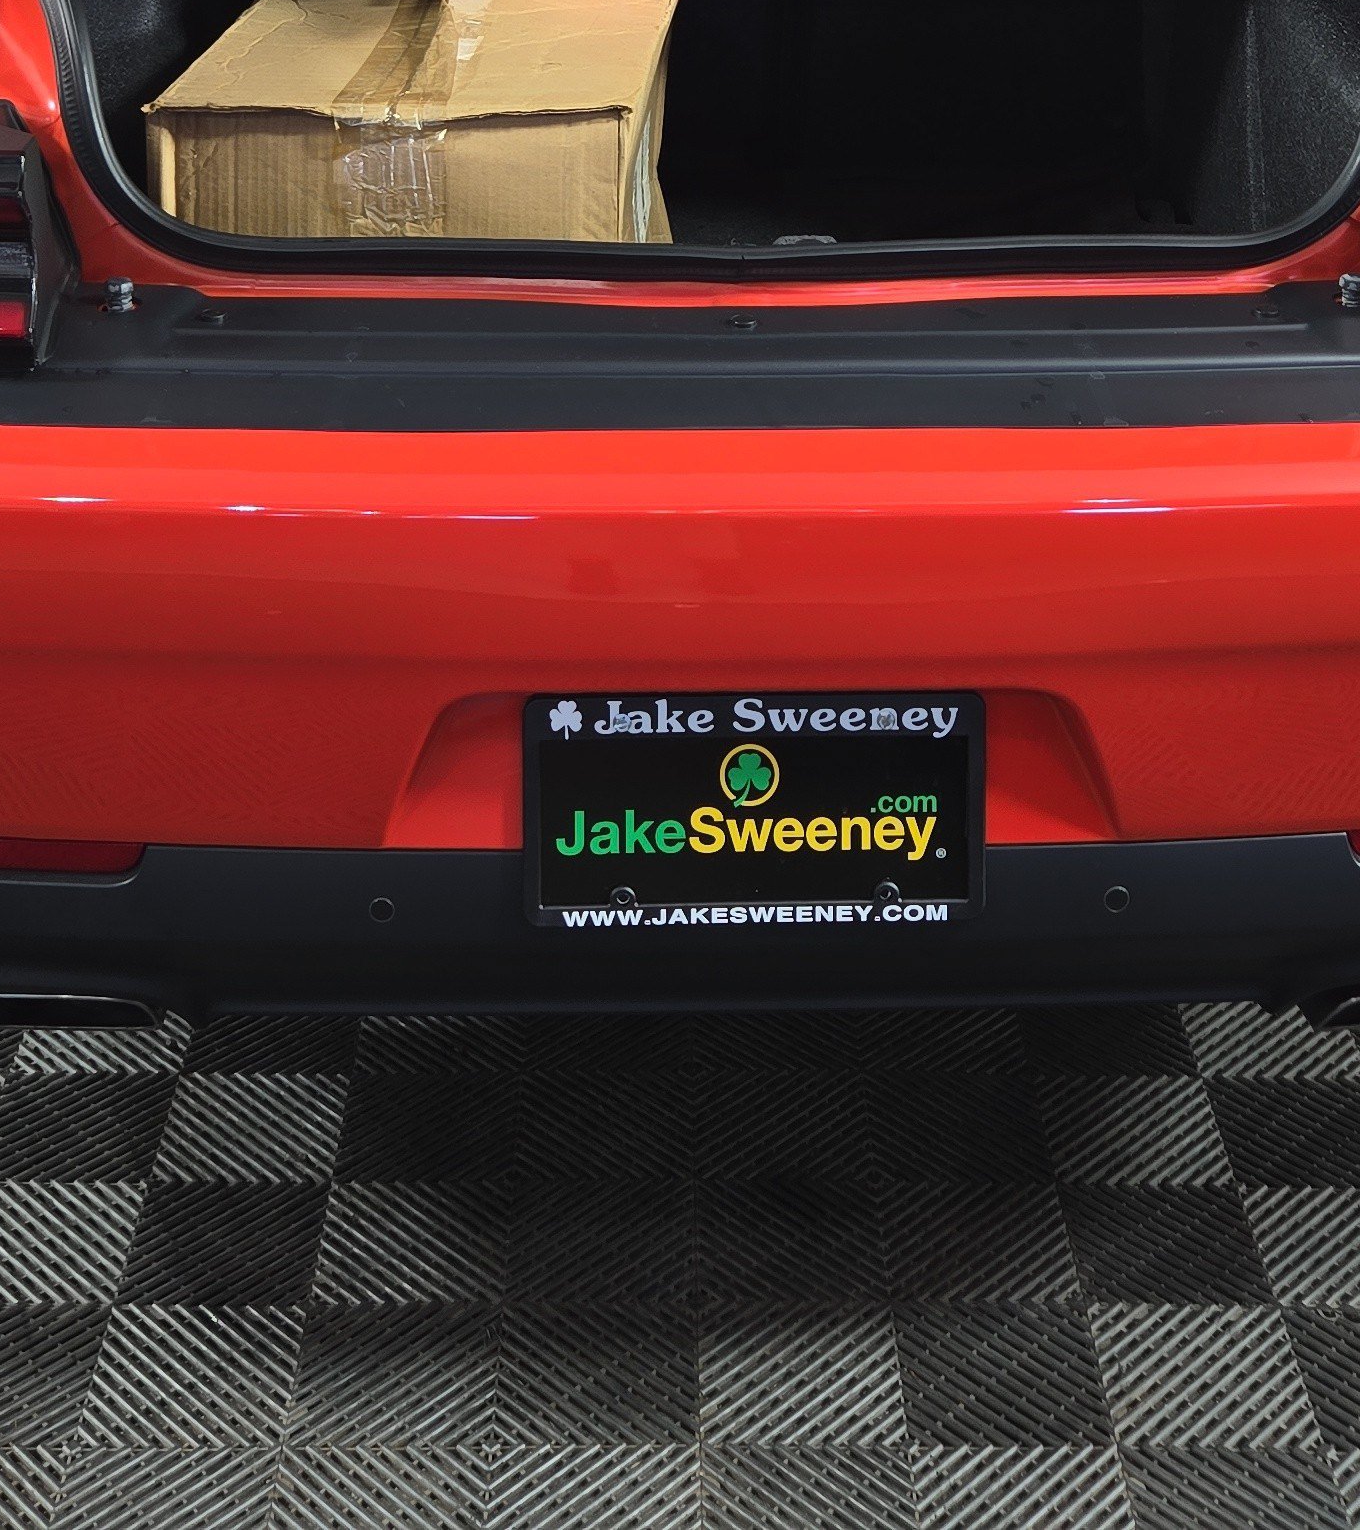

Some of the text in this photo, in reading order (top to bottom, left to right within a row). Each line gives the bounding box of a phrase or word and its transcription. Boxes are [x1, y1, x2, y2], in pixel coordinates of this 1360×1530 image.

[594, 698, 959, 738] Jake Sweeney
[562, 904, 948, 928] WWW.JAKESWEENEY.COM
